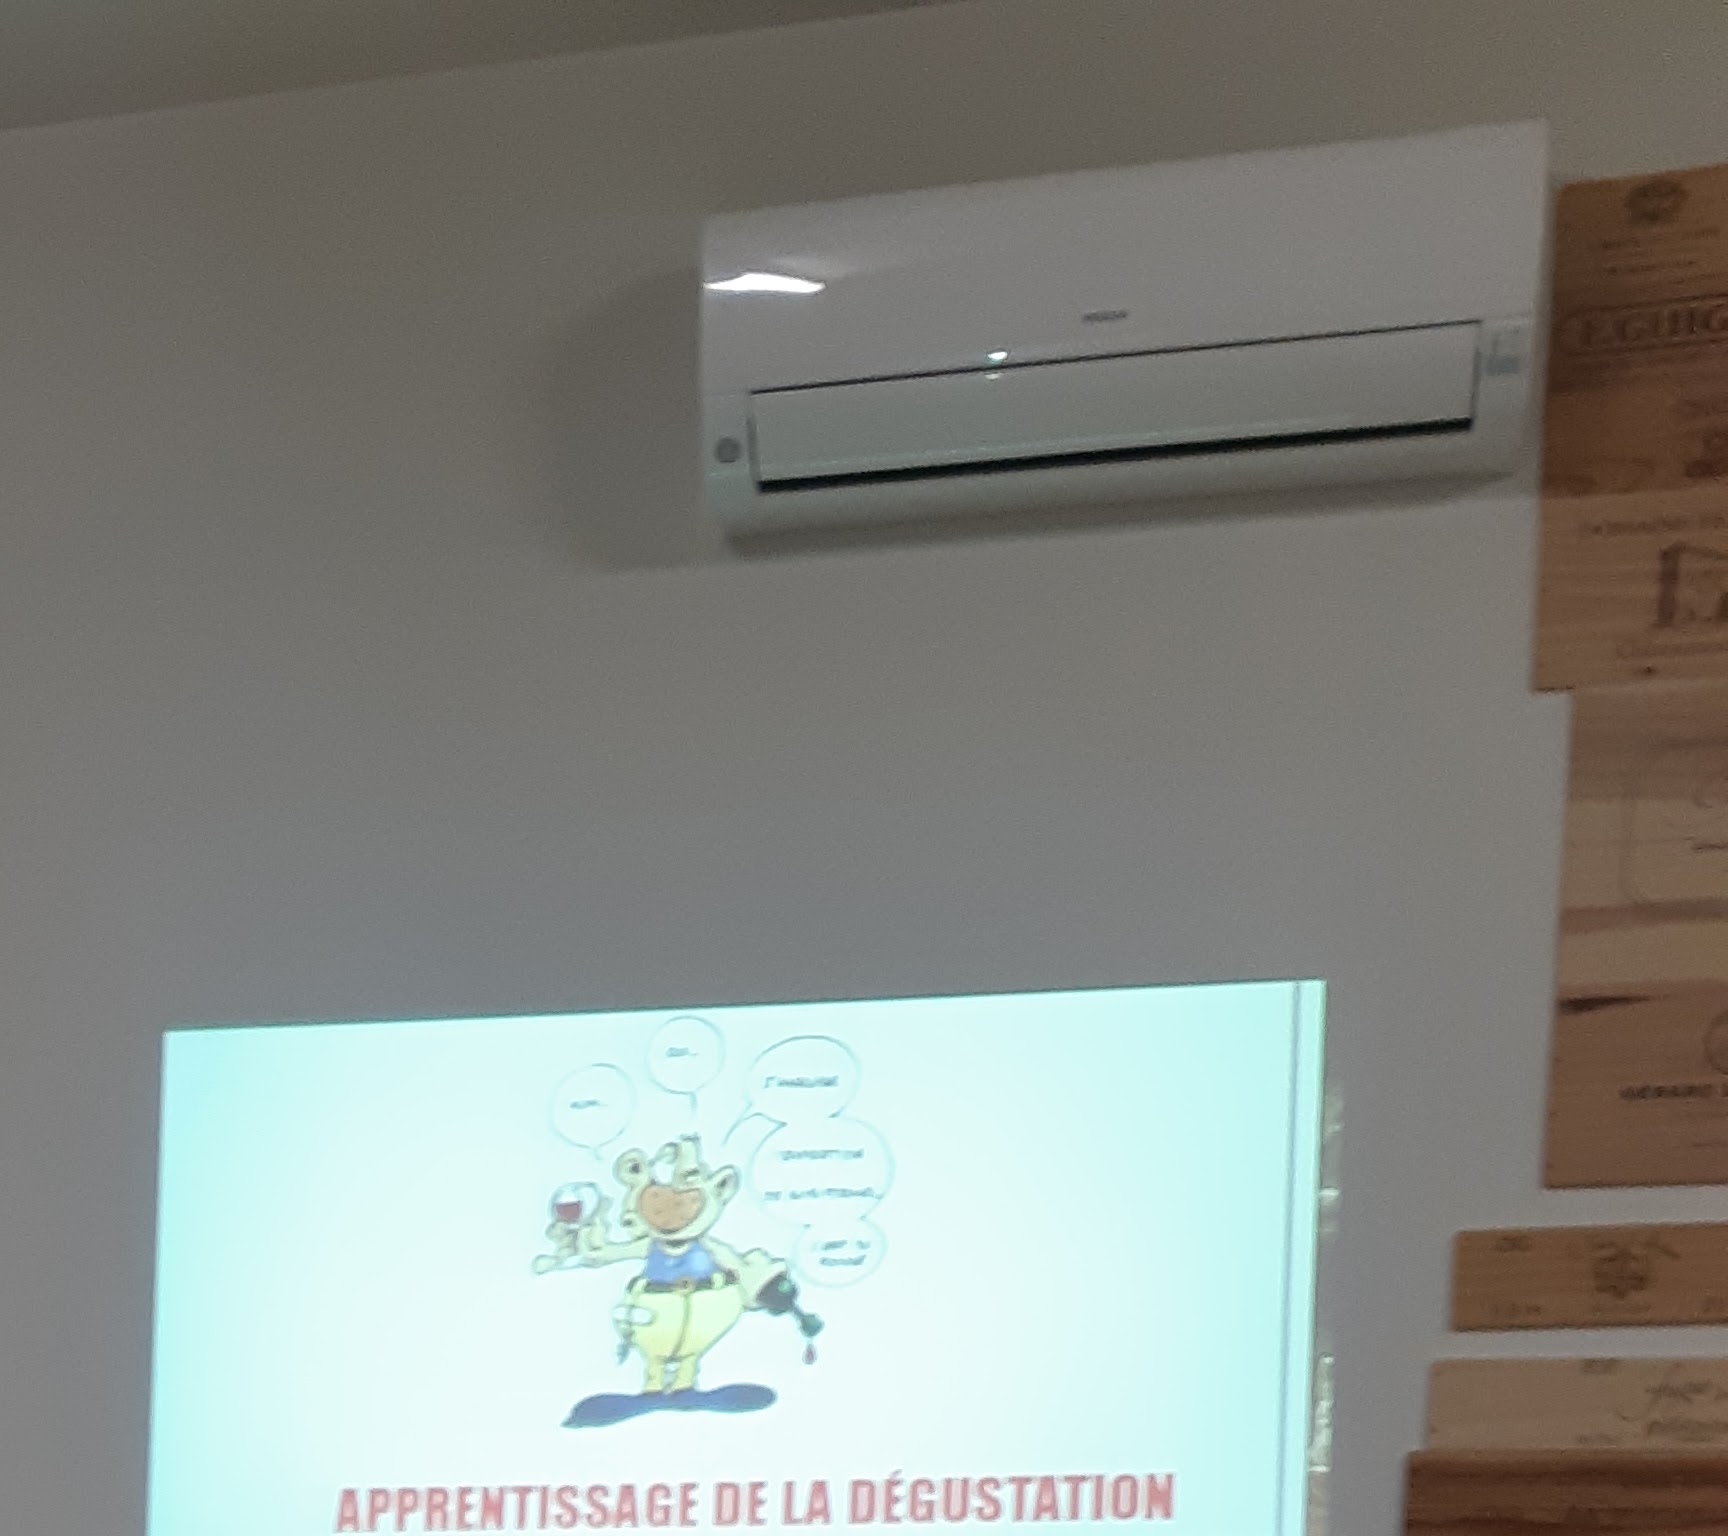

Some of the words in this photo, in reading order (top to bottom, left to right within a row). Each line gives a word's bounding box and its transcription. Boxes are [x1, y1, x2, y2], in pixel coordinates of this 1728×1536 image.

[336, 1482, 698, 1534] APPRENTISSAGE
[715, 1482, 766, 1526] DE
[781, 1480, 831, 1526] LA
[848, 1471, 1175, 1524] DÉGUSTATION
